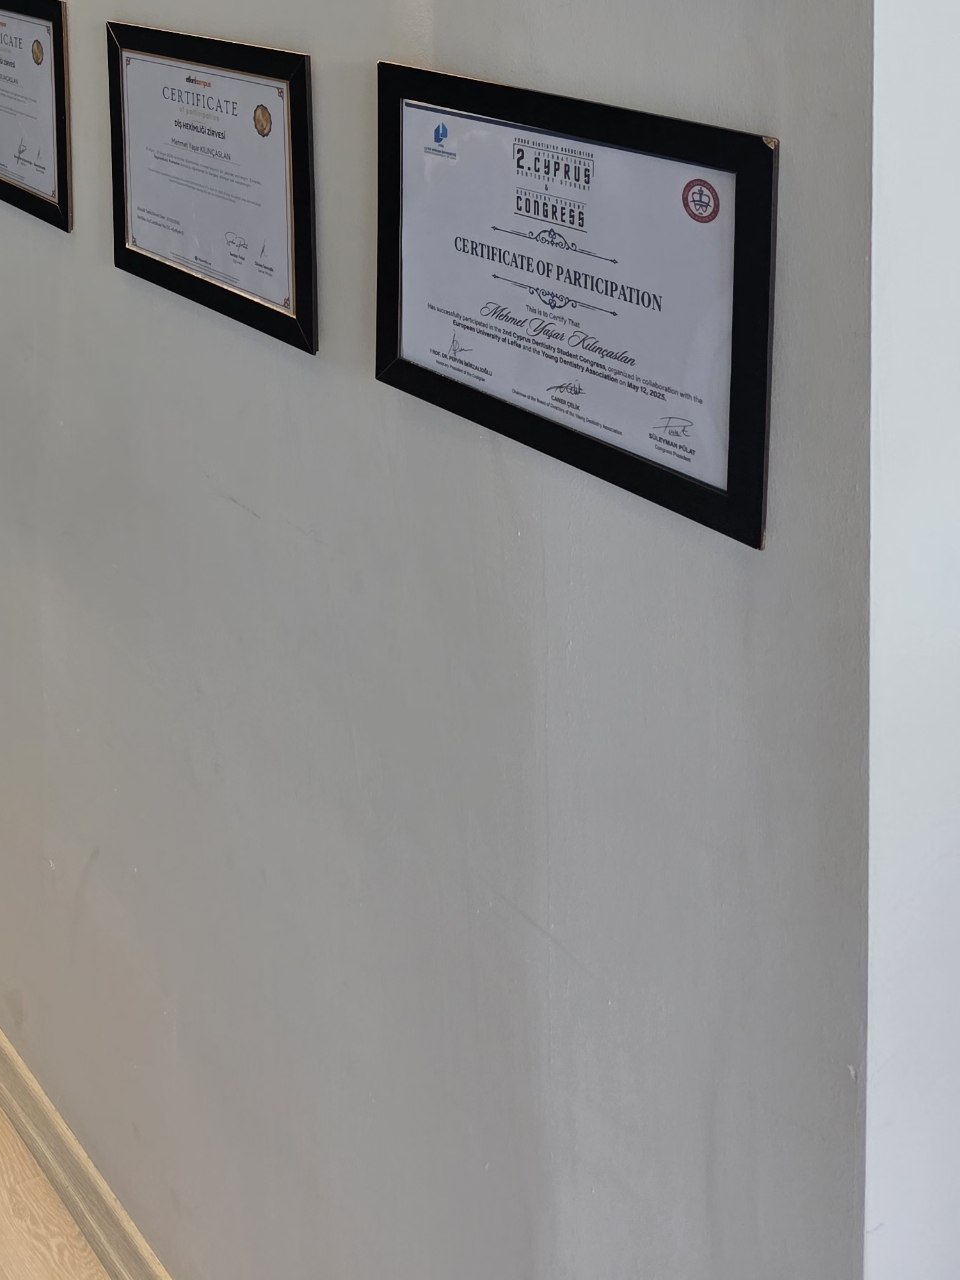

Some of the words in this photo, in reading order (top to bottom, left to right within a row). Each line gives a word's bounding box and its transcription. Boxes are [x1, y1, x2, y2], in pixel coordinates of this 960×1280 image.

[161, 86, 238, 117] CERTIFICATE
[516, 195, 585, 228] CONGRESS
[454, 235, 535, 274] CERTIFICATE
[536, 259, 554, 279] OF
[556, 265, 663, 313] PARTICIPATION
[480, 301, 529, 328] Mehmet
[526, 317, 566, 341] Yaşar
[567, 330, 636, 366] Kılınçaslan
[525, 304, 537, 315] This
[567, 318, 581, 329] That
[427, 302, 437, 312] Has
[502, 328, 512, 338] 2nd
[512, 330, 531, 344] Cyprus
[532, 337, 556, 354] Dentistry
[556, 347, 578, 361] Student
[579, 355, 607, 373] Congress,
[642, 377, 679, 396] collaboration
[452, 319, 476, 333] European
[476, 328, 502, 343] University
[541, 349, 559, 364] Young
[559, 355, 584, 373] Dentistry
[584, 363, 619, 384] Association
[626, 380, 640, 393] May
[648, 432, 678, 449] SÜLEYMAN
